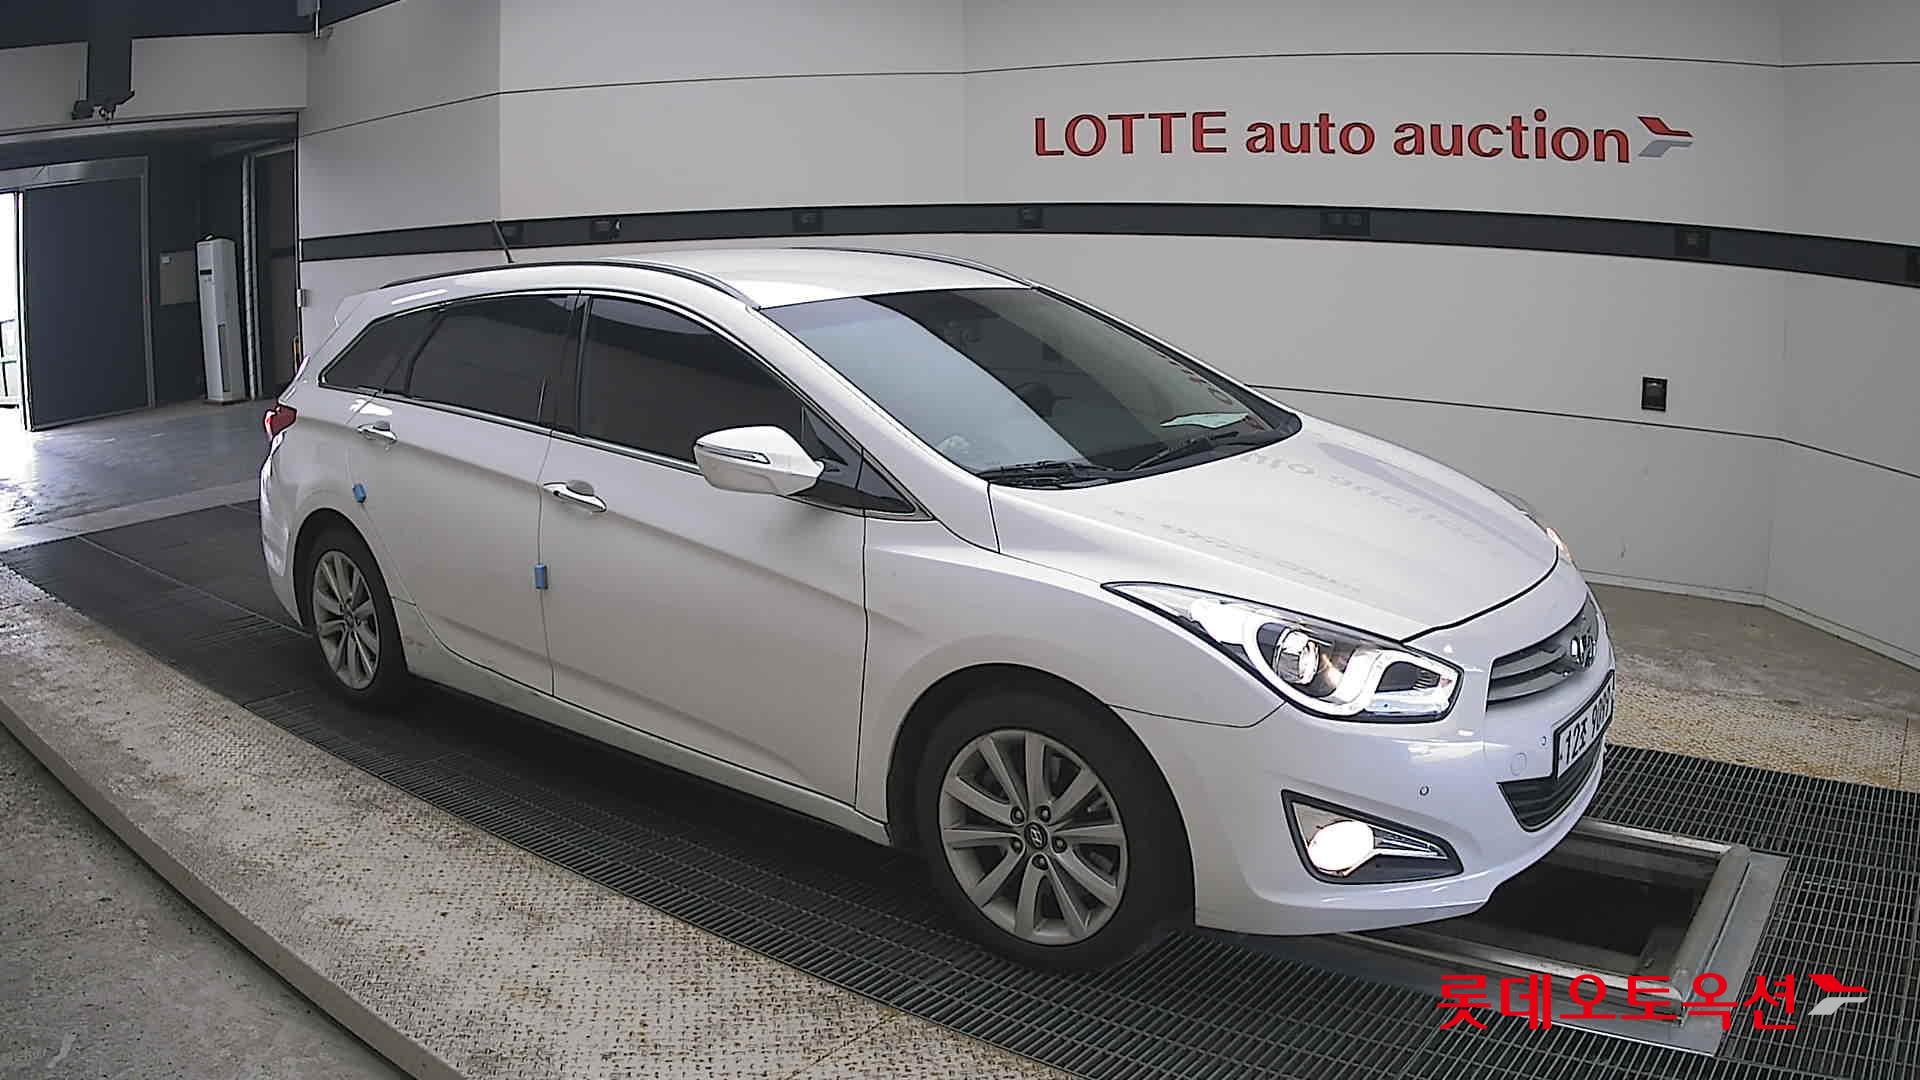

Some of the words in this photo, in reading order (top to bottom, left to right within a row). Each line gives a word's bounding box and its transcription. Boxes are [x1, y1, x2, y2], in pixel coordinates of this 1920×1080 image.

[1034, 111, 1227, 157] LOTTE
[1245, 112, 1375, 155] auto
[1393, 108, 1630, 163] auction
